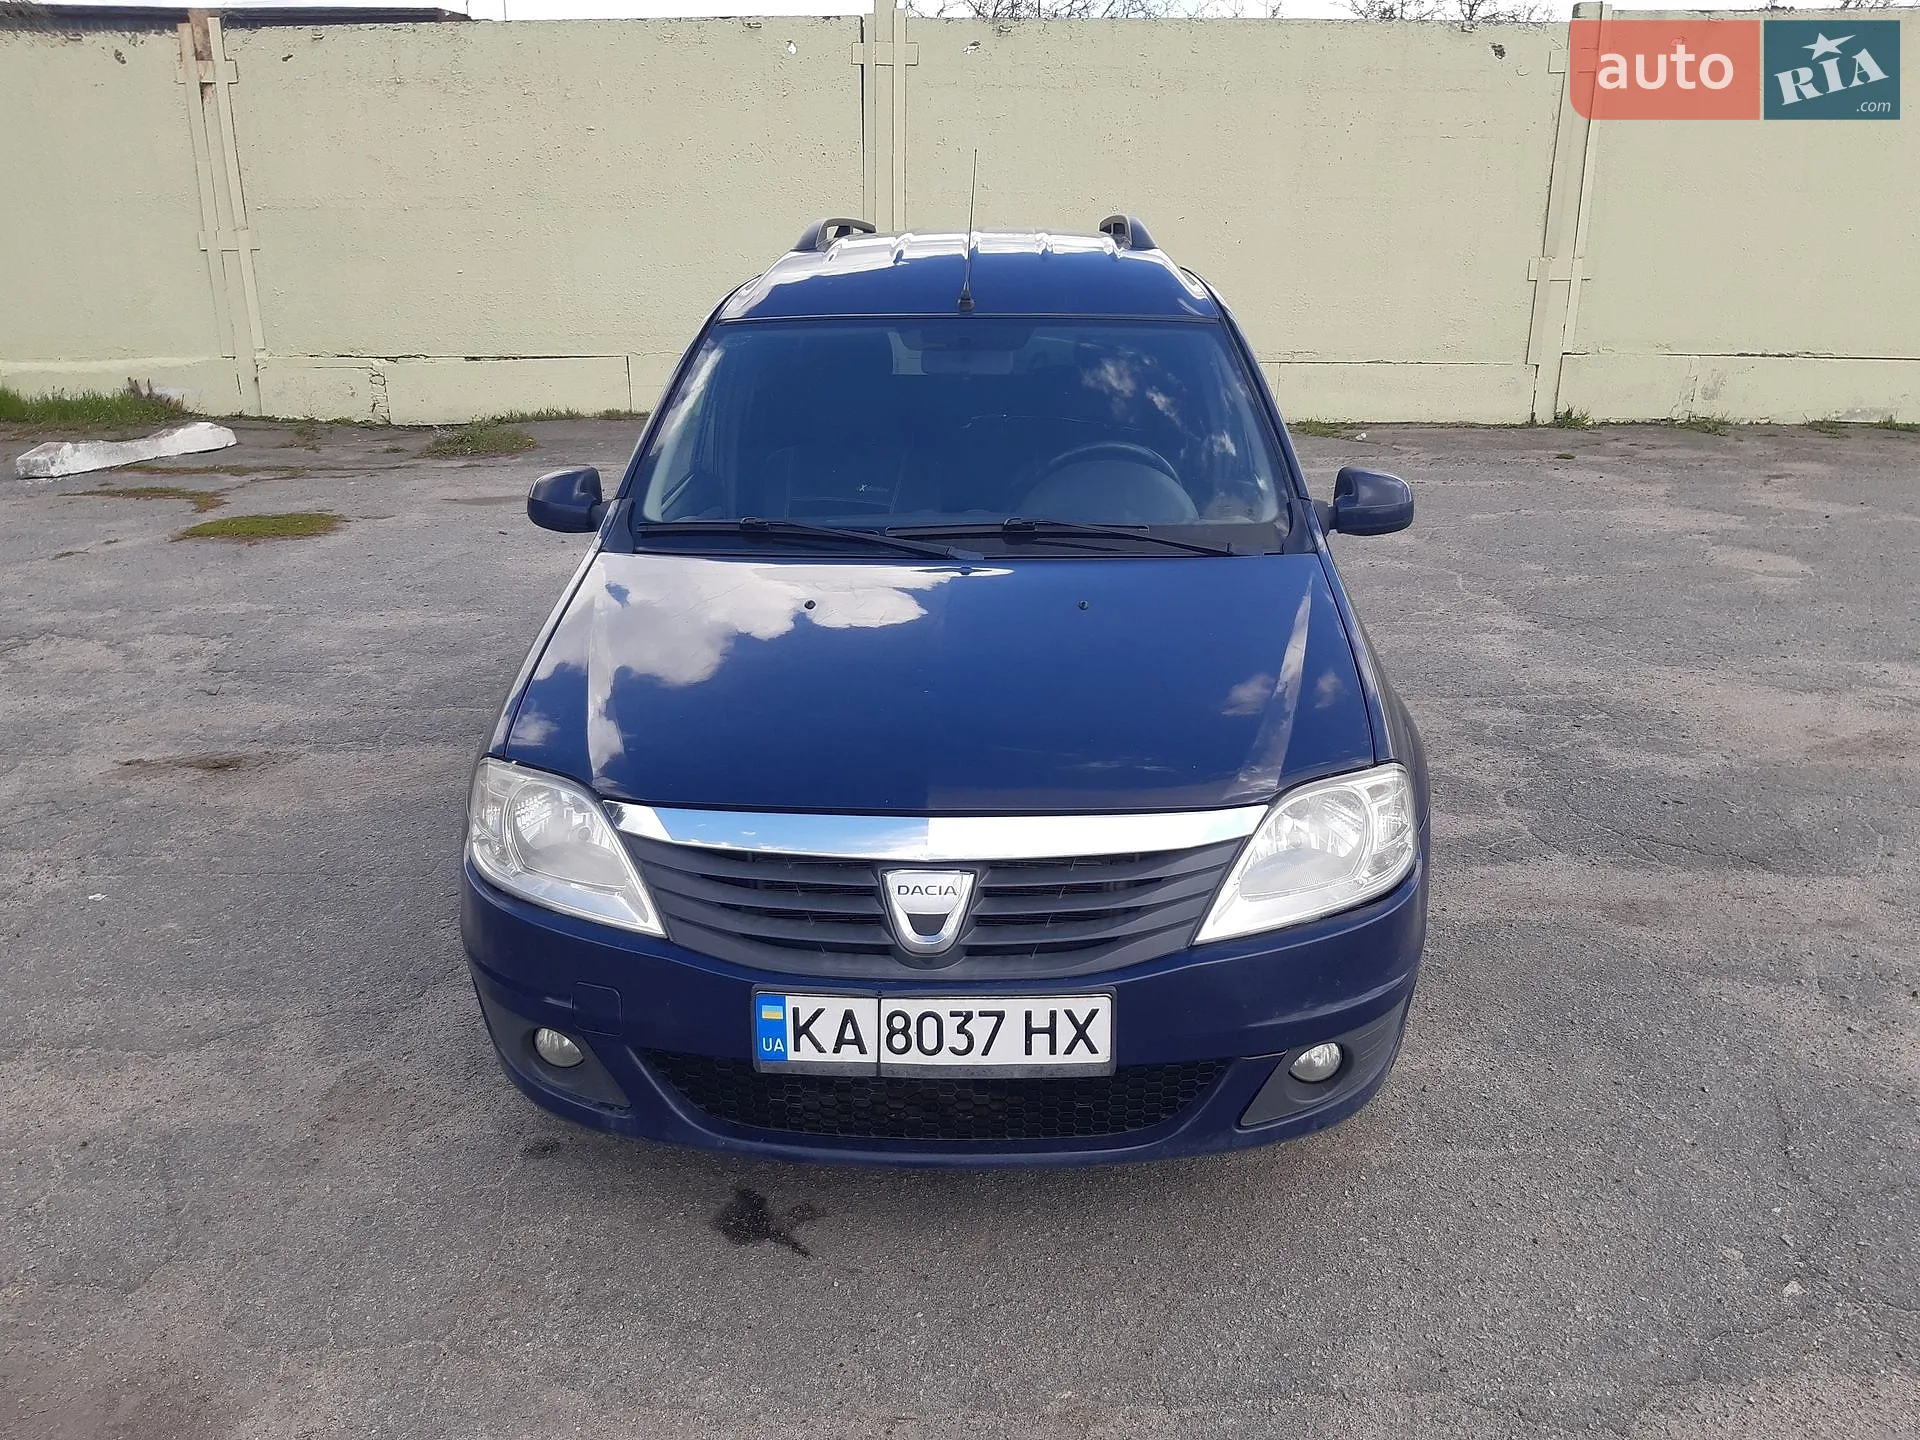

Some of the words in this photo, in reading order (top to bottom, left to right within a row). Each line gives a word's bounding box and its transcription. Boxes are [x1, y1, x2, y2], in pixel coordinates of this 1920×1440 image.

[897, 885, 957, 896] DACIA
[792, 1006, 868, 1055] KA
[885, 1009, 1006, 1057] 8037
[1024, 1008, 1100, 1056] HX
[763, 1037, 784, 1052] UA
